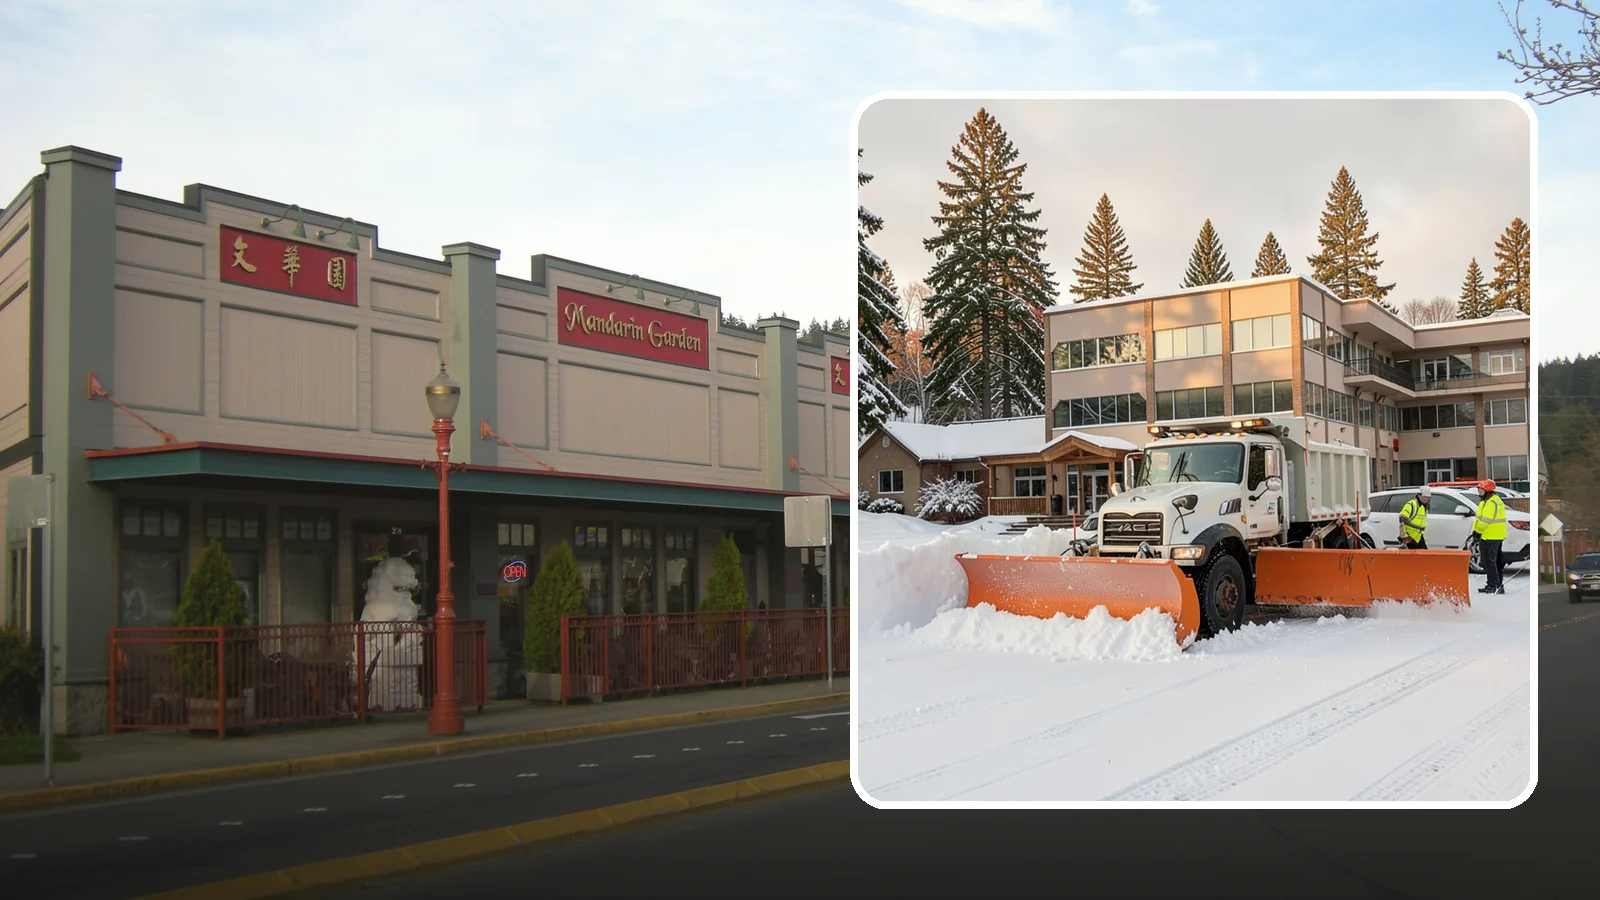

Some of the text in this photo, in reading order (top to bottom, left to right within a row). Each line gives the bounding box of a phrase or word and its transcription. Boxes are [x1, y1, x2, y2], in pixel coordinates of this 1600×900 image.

[231, 236, 346, 291] 文華園
[564, 302, 701, 352] Mandarin Garden
[391, 526, 402, 535] 28
[503, 565, 527, 578] OPEN
